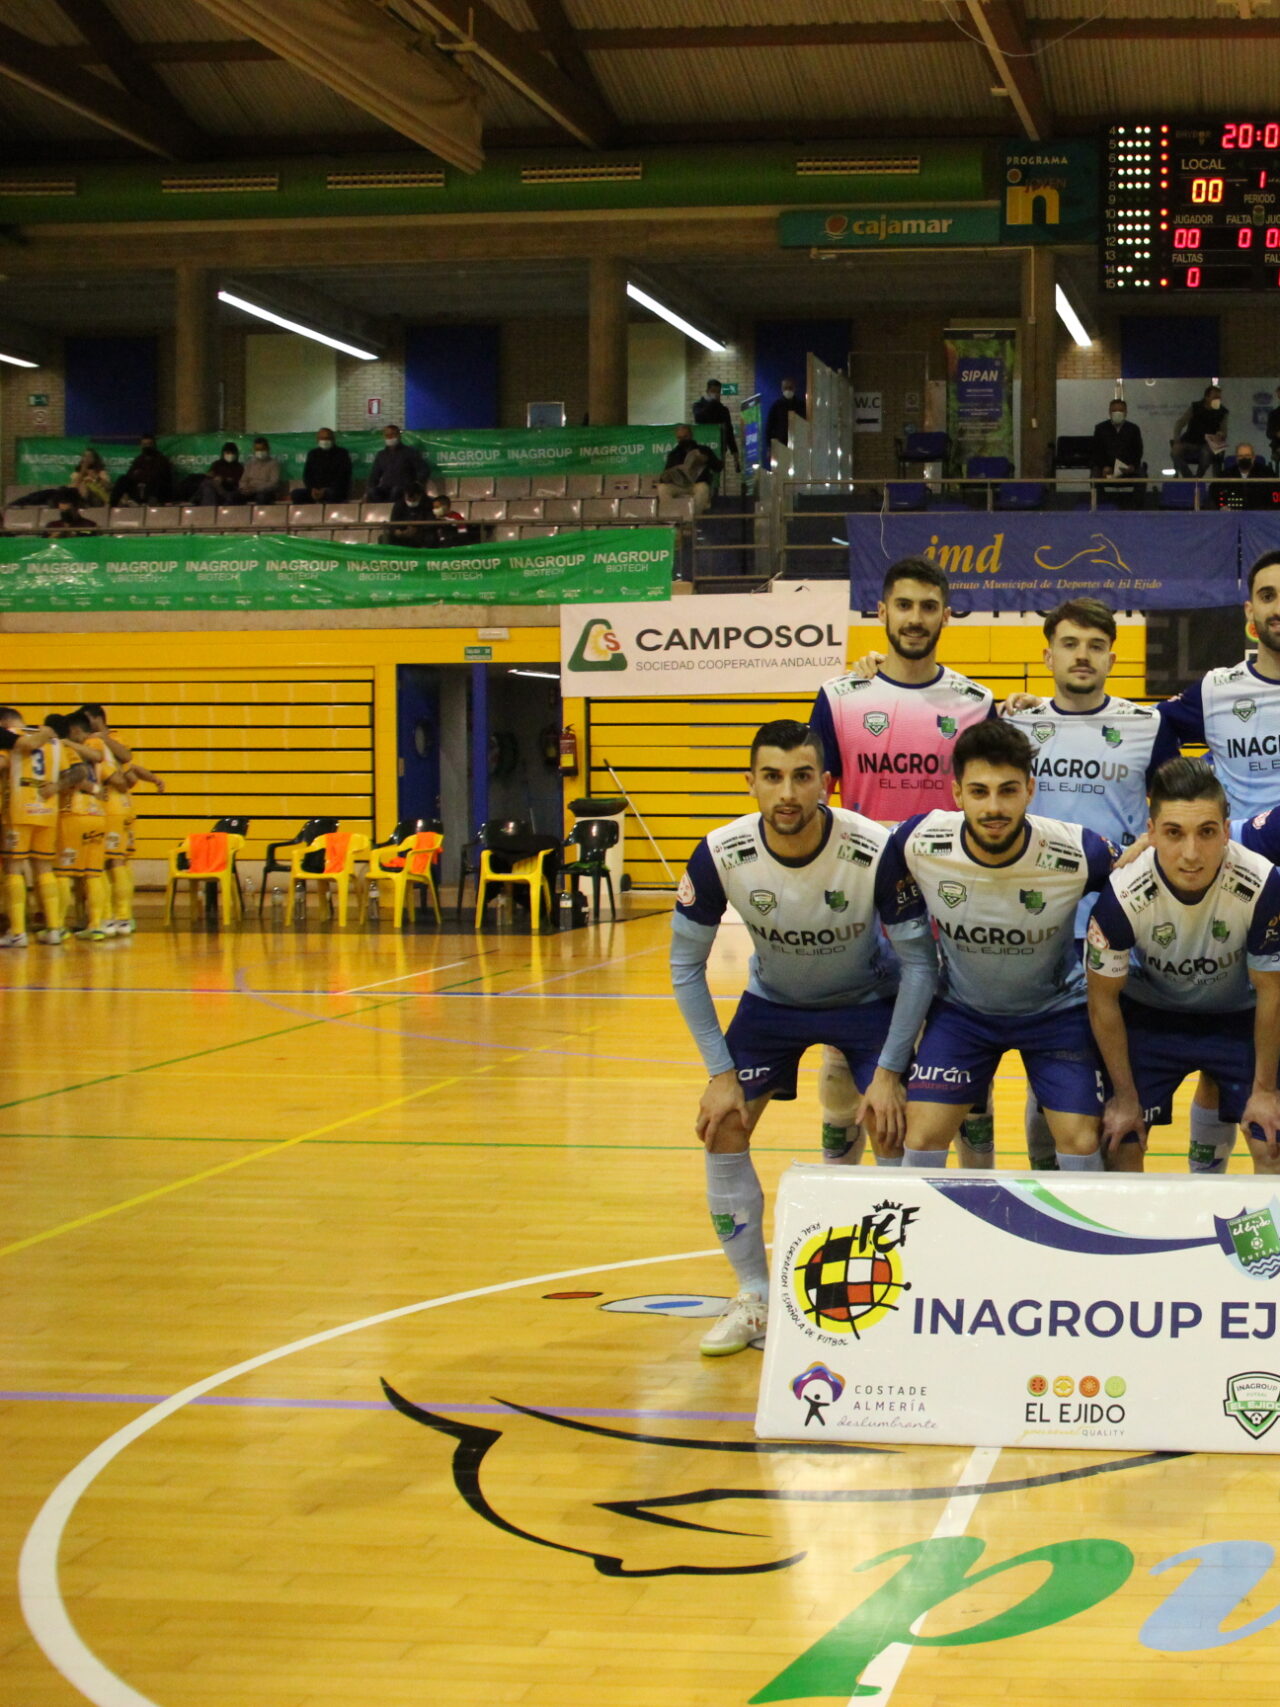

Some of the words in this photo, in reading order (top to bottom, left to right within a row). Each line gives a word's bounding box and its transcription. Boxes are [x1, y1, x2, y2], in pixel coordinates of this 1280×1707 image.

[1006, 155, 1069, 166] PROGRAMA
[1181, 158, 1226, 170] LOCAL
[1259, 170, 1268, 189] 1
[1191, 178, 1224, 204] 00
[1173, 214, 1213, 224] JUGADOR
[1226, 214, 1252, 224] FALTA
[853, 214, 952, 240] cajamar
[1174, 228, 1201, 248] 00
[1238, 228, 1252, 248] 0
[1172, 254, 1204, 263] FALTAS
[1186, 266, 1200, 288] 0
[961, 370, 998, 382] SIPAN
[854, 396, 881, 409] W.C
[436, 450, 500, 462] INAGROUP
[507, 448, 573, 460] INAGROUP
[579, 444, 645, 457] INAGROUP
[593, 550, 670, 564] INAGROUP
[926, 533, 1004, 574] imd
[106, 560, 178, 574] INAGROUP
[185, 560, 258, 572] INAGROUP
[266, 560, 339, 572] INAGROUP
[346, 560, 418, 572] INAGROUP
[426, 558, 500, 572] INAGROUP
[509, 554, 586, 570] INAGROUP
[606, 562, 649, 573] BIOTECH
[982, 580, 1038, 590] Municipal
[1041, 579, 1054, 590] de
[1056, 580, 1102, 591] Deportes
[1104, 580, 1116, 589] de
[1118, 580, 1131, 589] El
[1134, 580, 1162, 590] Ejido
[635, 624, 842, 652] CAMPOSOL
[636, 659, 695, 672] SOCIEDAD
[698, 658, 779, 670] COOPERATIVA
[780, 656, 842, 668] ANDALUZA
[1248, 760, 1268, 772] EL
[879, 778, 898, 790] EL
[902, 778, 944, 790] EJIDO
[1039, 782, 1058, 792] EL
[1061, 782, 1106, 795] EJIDO
[795, 946, 846, 955] EJIDO
[981, 946, 1034, 955] EJIDO
[913, 1297, 1202, 1340] INAGROUP
[804, 1328, 816, 1338] DE
[1236, 1382, 1278, 1392] INAGROUP
[853, 1400, 926, 1412] ALMERÍA
[1025, 1402, 1050, 1422] EL
[1059, 1402, 1126, 1424] EJIDO
[836, 1415, 938, 1430] deslumbrante
[1082, 1428, 1125, 1437] QUALITY
